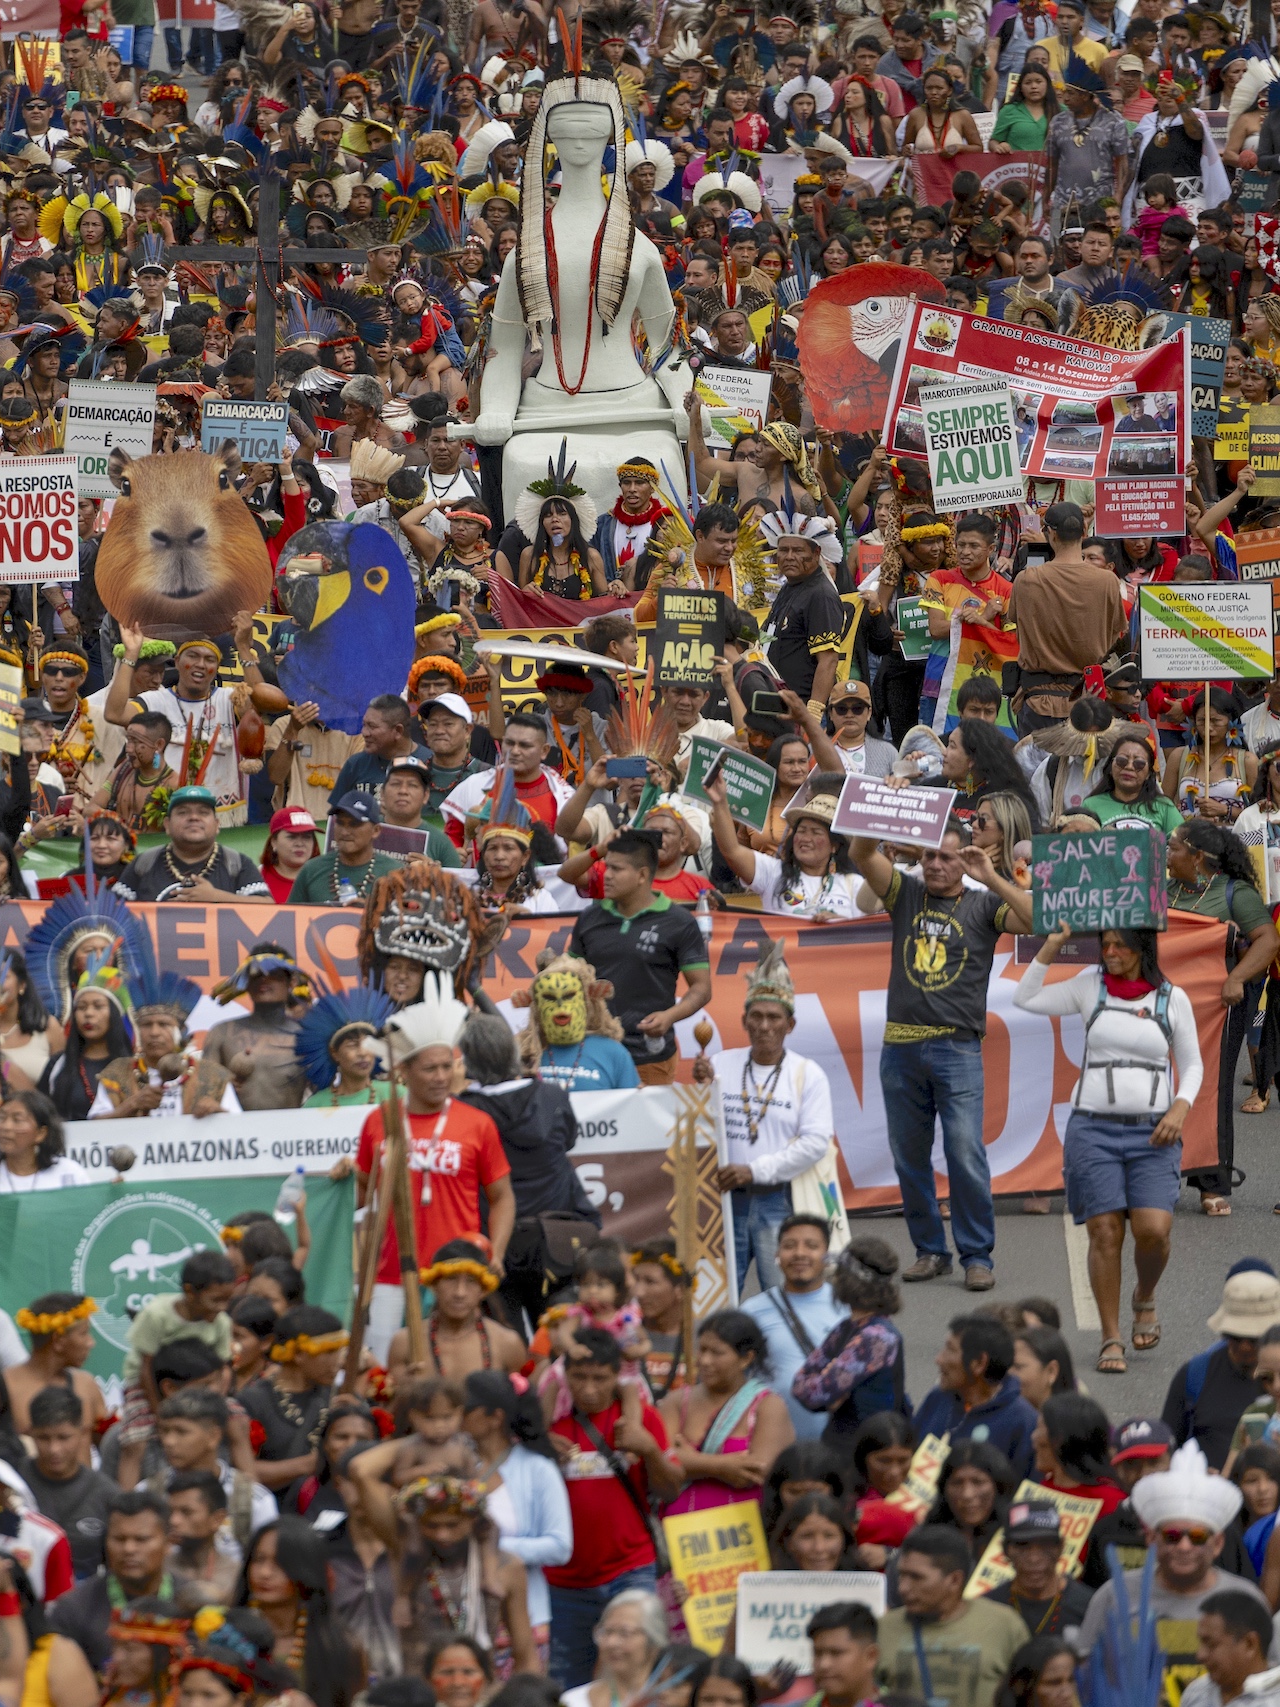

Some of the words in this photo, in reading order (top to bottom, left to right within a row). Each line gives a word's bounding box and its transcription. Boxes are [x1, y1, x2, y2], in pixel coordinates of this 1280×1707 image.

[924, 313, 937, 322] ATY
[939, 311, 958, 328] GUASU
[971, 320, 1021, 342] GRANDE
[1024, 332, 1101, 359] ASSEMBLEIA
[1103, 351, 1120, 363] DO
[1016, 355, 1029, 367] 08
[1032, 359, 1039, 369] a
[1042, 361, 1055, 373] 14
[1057, 366, 1108, 382] Dezembro
[1022, 367, 1039, 377] Aldeia
[1065, 354, 1112, 374] KAIOWÁ
[716, 374, 753, 385] FEDERAL
[1026, 381, 1039, 389] sem
[723, 385, 750, 395] JUSTIÇA
[921, 381, 1007, 400] #MARCOTEMPORALNÃO
[738, 396, 764, 404] Indígenas
[70, 405, 152, 426] DEMARCAÇÃO
[207, 403, 284, 422] DEMARCAÇÃO
[927, 402, 1009, 434] SEMPRE
[239, 421, 247, 434] É
[104, 431, 112, 447] É
[930, 425, 1012, 451] ESTIVEMOS
[1229, 444, 1239, 452] DE
[936, 443, 1013, 486] AQUI
[6, 475, 74, 492] RESPOSTA
[1104, 482, 1117, 491] POR
[1117, 482, 1128, 490] UM
[1128, 481, 1150, 490] PLANO
[1151, 480, 1178, 489] NACIONAL
[936, 487, 1022, 508] #MARCOTEMPORALNÃO
[1112, 493, 1120, 501] DE
[1121, 491, 1151, 501] EDUCAÇÃO
[1152, 491, 1168, 500] (PNE)
[1105, 503, 1119, 512] PELA
[1121, 500, 1155, 512] EFETIVAÇÃO
[1156, 501, 1165, 510] DA
[1166, 500, 1175, 509] LEI
[1121, 512, 1160, 521] 11.645/2008
[664, 594, 717, 615] DIREITOS
[1159, 593, 1204, 601] GOVERNO
[1207, 592, 1251, 600] FEDERAL
[664, 611, 717, 622] TERRITORIAIS
[914, 608, 922, 616] UM
[1161, 604, 1203, 613] MINISTÉRIO
[1218, 604, 1249, 613] JUSTIÇA
[910, 621, 916, 629] DE
[1145, 615, 1175, 623] Fundação
[1236, 614, 1266, 622] Indígenas
[1146, 628, 1188, 639] TERRA
[1192, 628, 1267, 638] PROTEGIDA
[661, 639, 716, 673] AÇÃO
[660, 668, 713, 683] CLIMÁTICA
[697, 745, 709, 756] POR
[745, 763, 770, 787] NACIONAL
[739, 775, 764, 796] ESCOLAR
[859, 781, 878, 793] POR
[866, 792, 883, 804] QUE
[885, 794, 918, 809] RESPEITE
[849, 802, 898, 818] DIVERSIDADE
[900, 808, 938, 824] CULTURAL!
[1048, 836, 1116, 865] SALVE
[1079, 863, 1092, 884] A
[1042, 886, 1145, 912] NATUREZA
[1042, 905, 1145, 931] URGENTE
[143, 1137, 259, 1165] AMAZONAS
[679, 1530, 709, 1559] FIM
[715, 1523, 754, 1550] DOS
